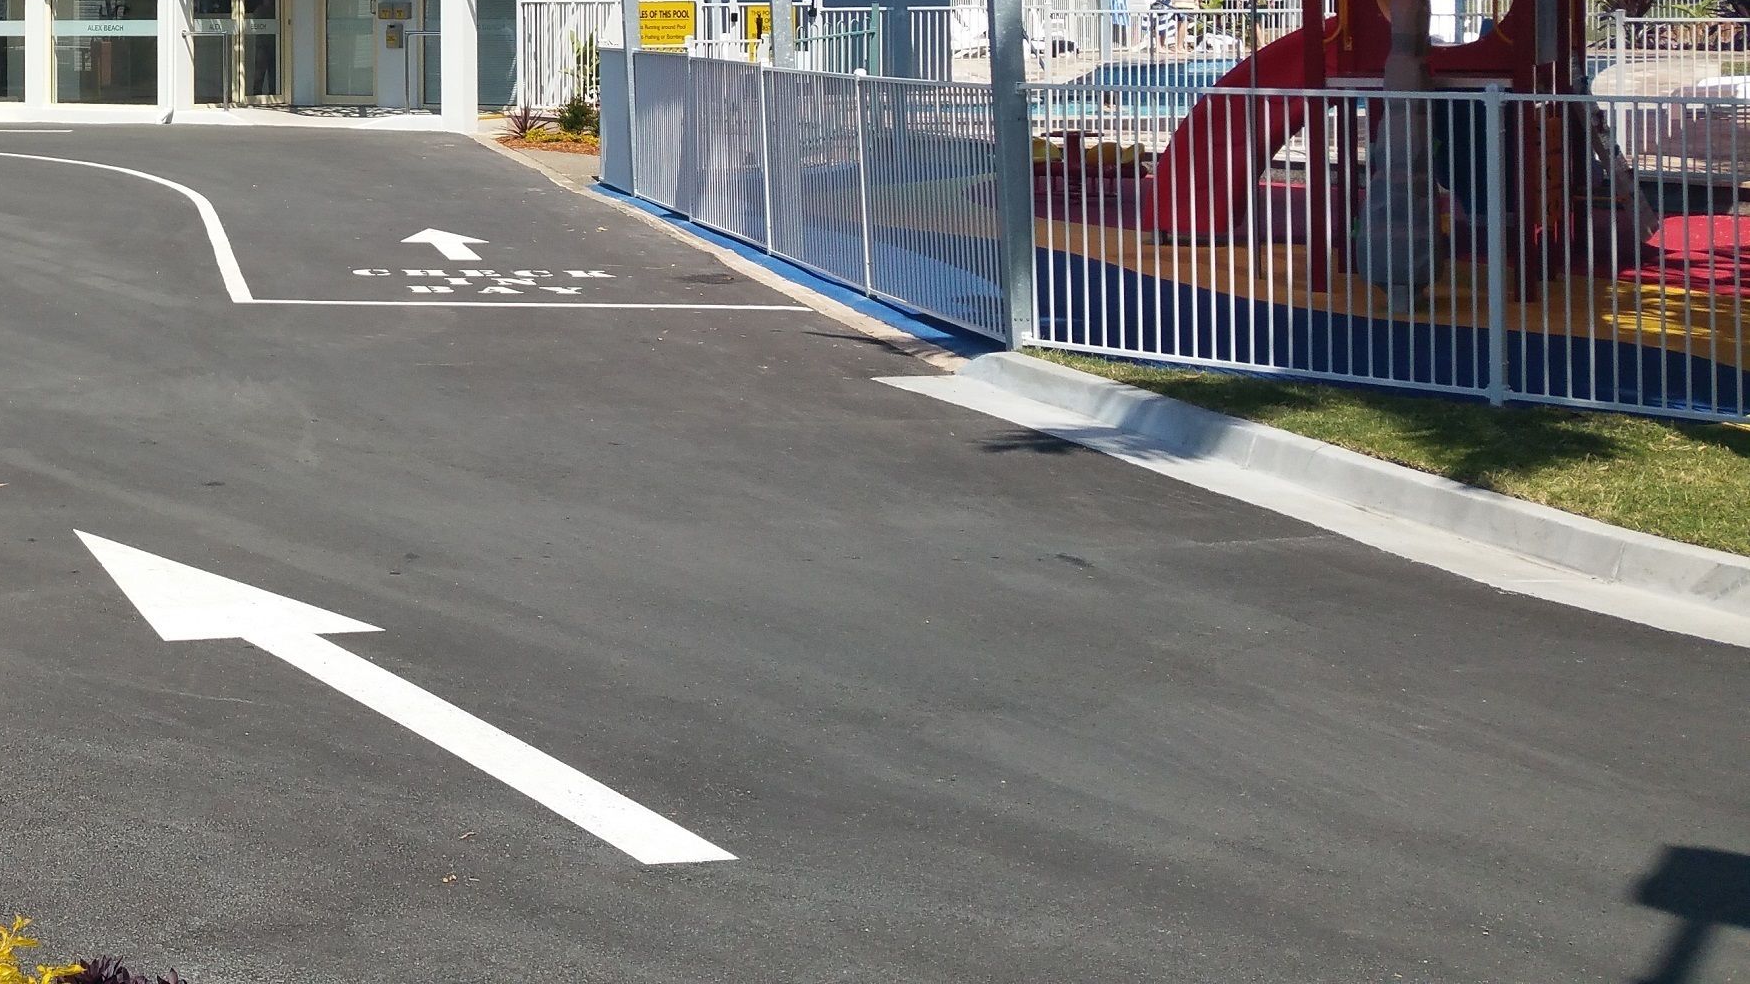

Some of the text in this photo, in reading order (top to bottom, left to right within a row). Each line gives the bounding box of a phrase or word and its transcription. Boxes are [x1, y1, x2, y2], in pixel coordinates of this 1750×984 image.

[650, 10, 657, 18] OF
[659, 10, 671, 18] THIS
[673, 10, 689, 18] POOL
[352, 269, 617, 278] CHECK
[444, 278, 537, 286] IN
[406, 286, 583, 294] BAY
